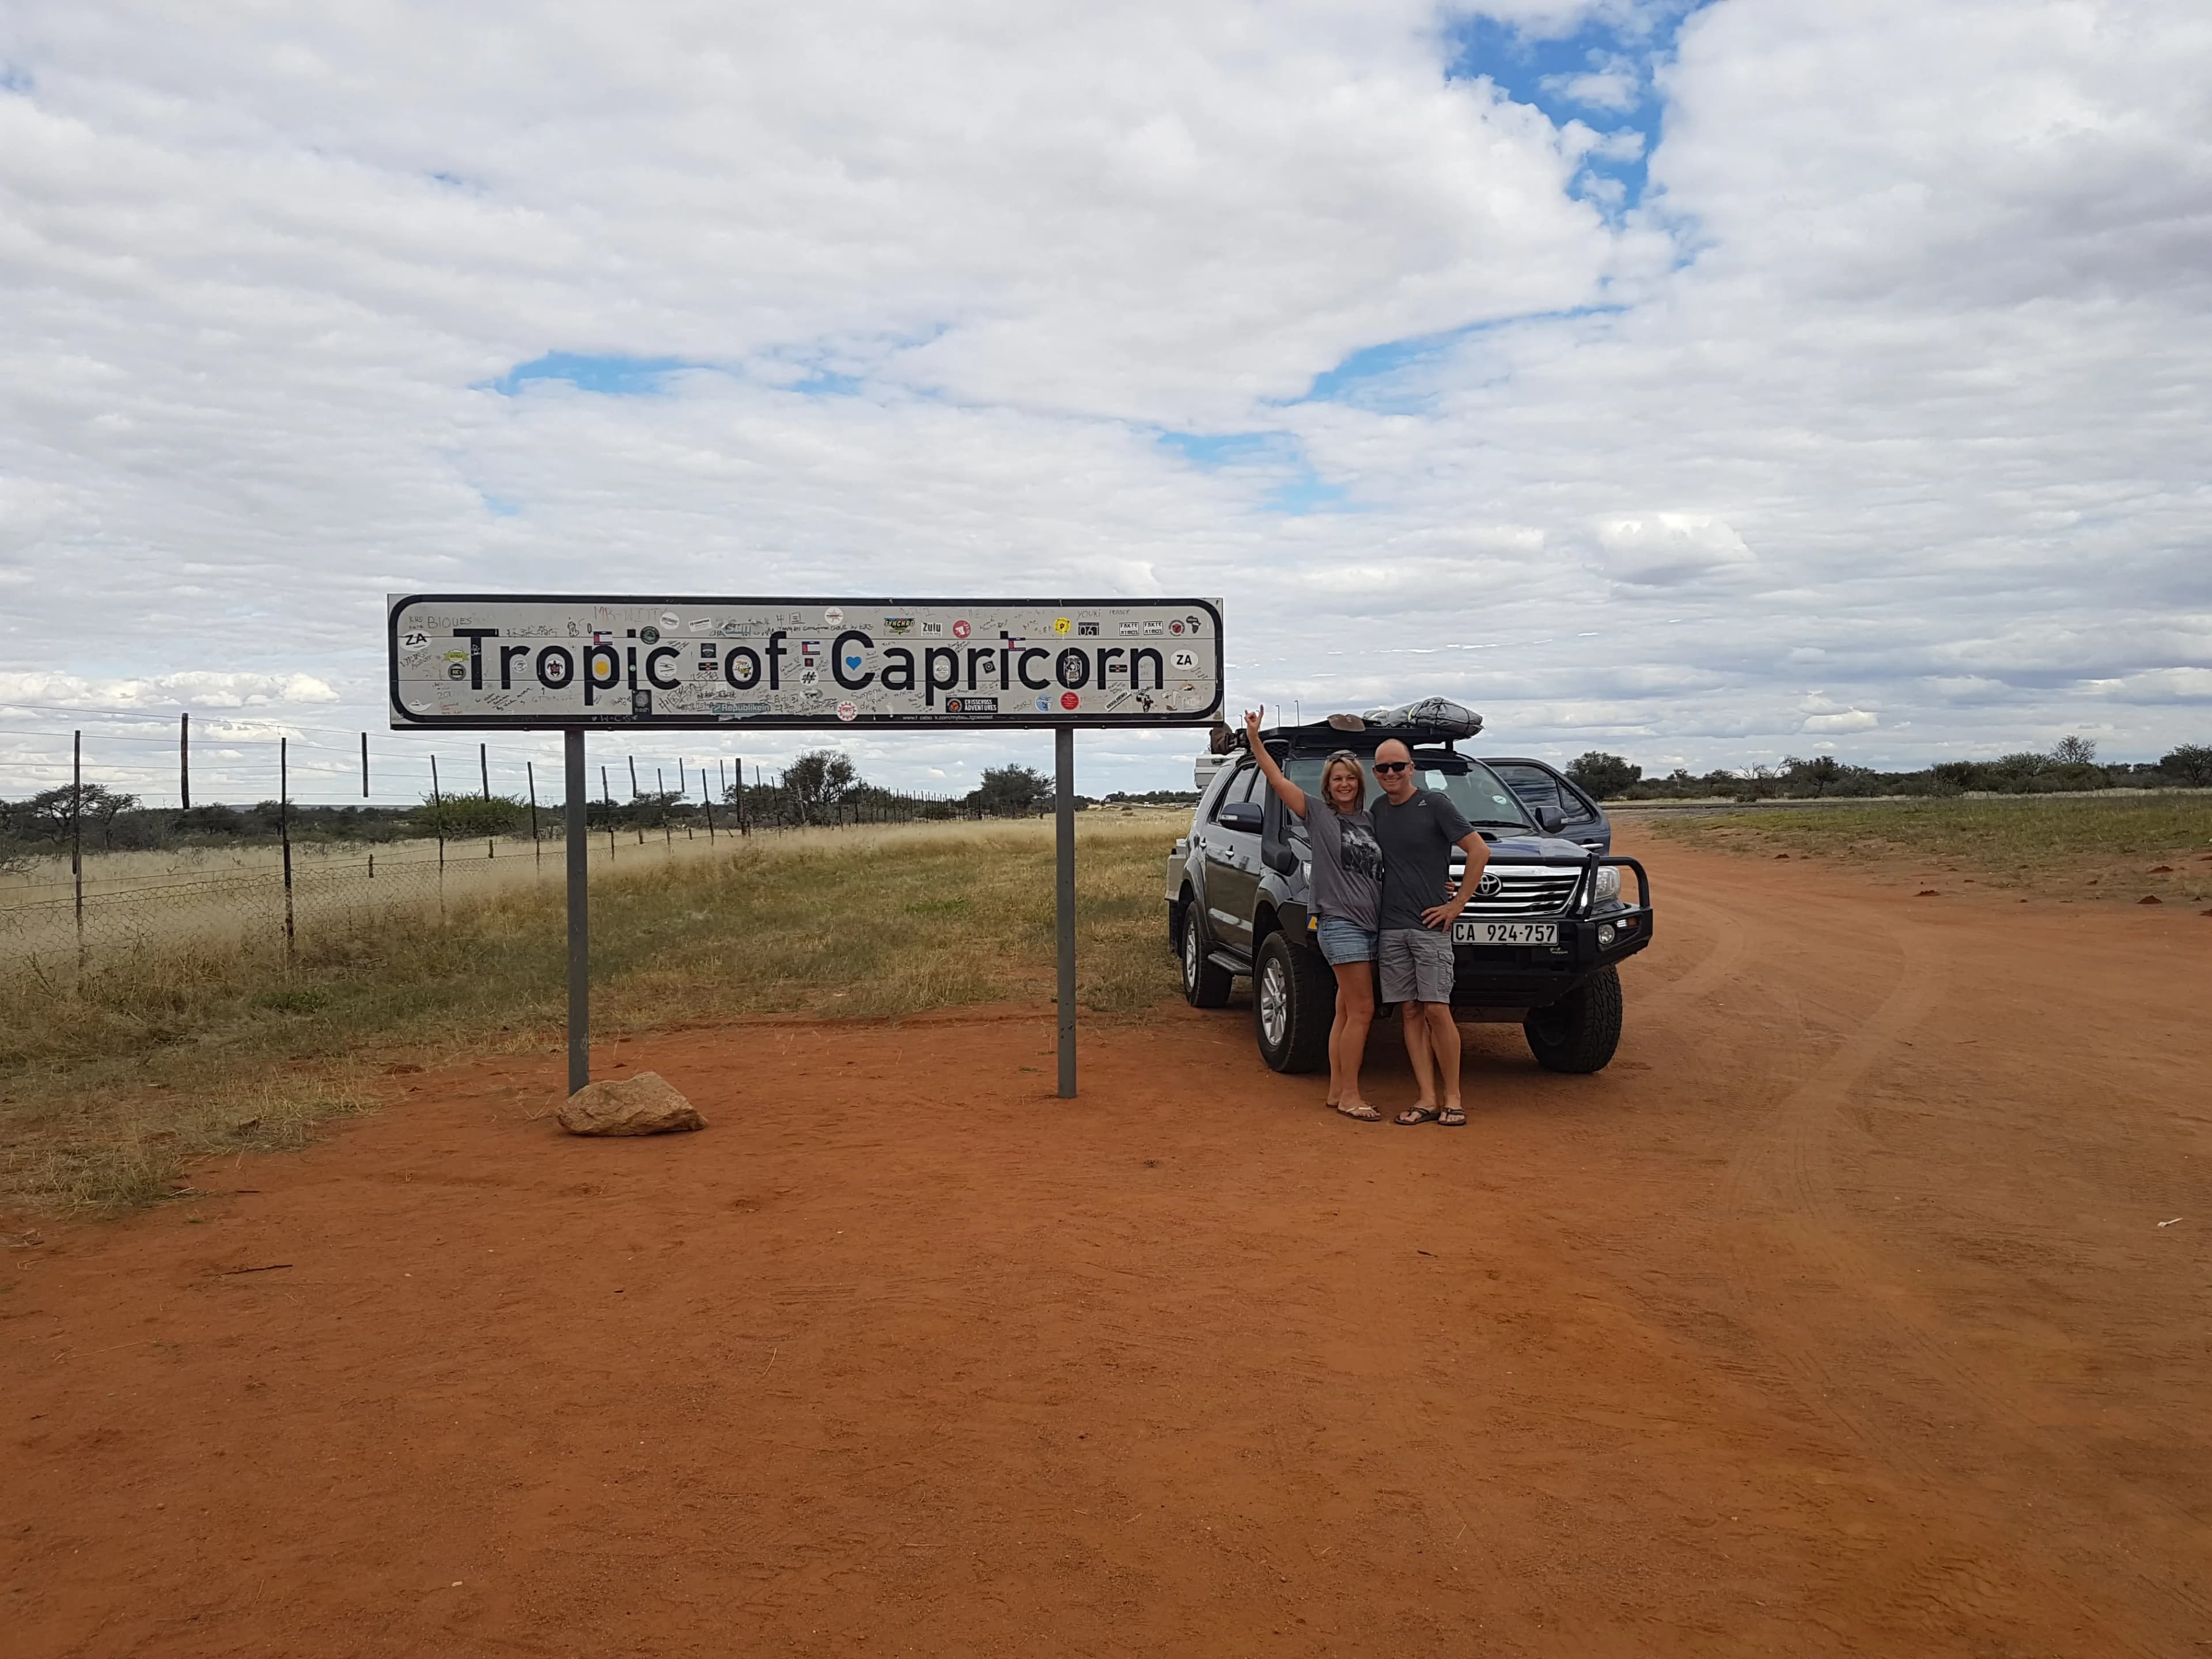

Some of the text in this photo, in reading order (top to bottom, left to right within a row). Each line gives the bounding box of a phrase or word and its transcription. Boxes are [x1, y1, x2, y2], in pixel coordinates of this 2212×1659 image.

[922, 622, 941, 632] Zulu
[405, 633, 427, 645] ZA
[1176, 654, 1192, 665] ZA
[453, 628, 1163, 706] Tropic of Capricorn
[722, 703, 770, 713] Republikein
[1455, 925, 1555, 942] CA 924-757
